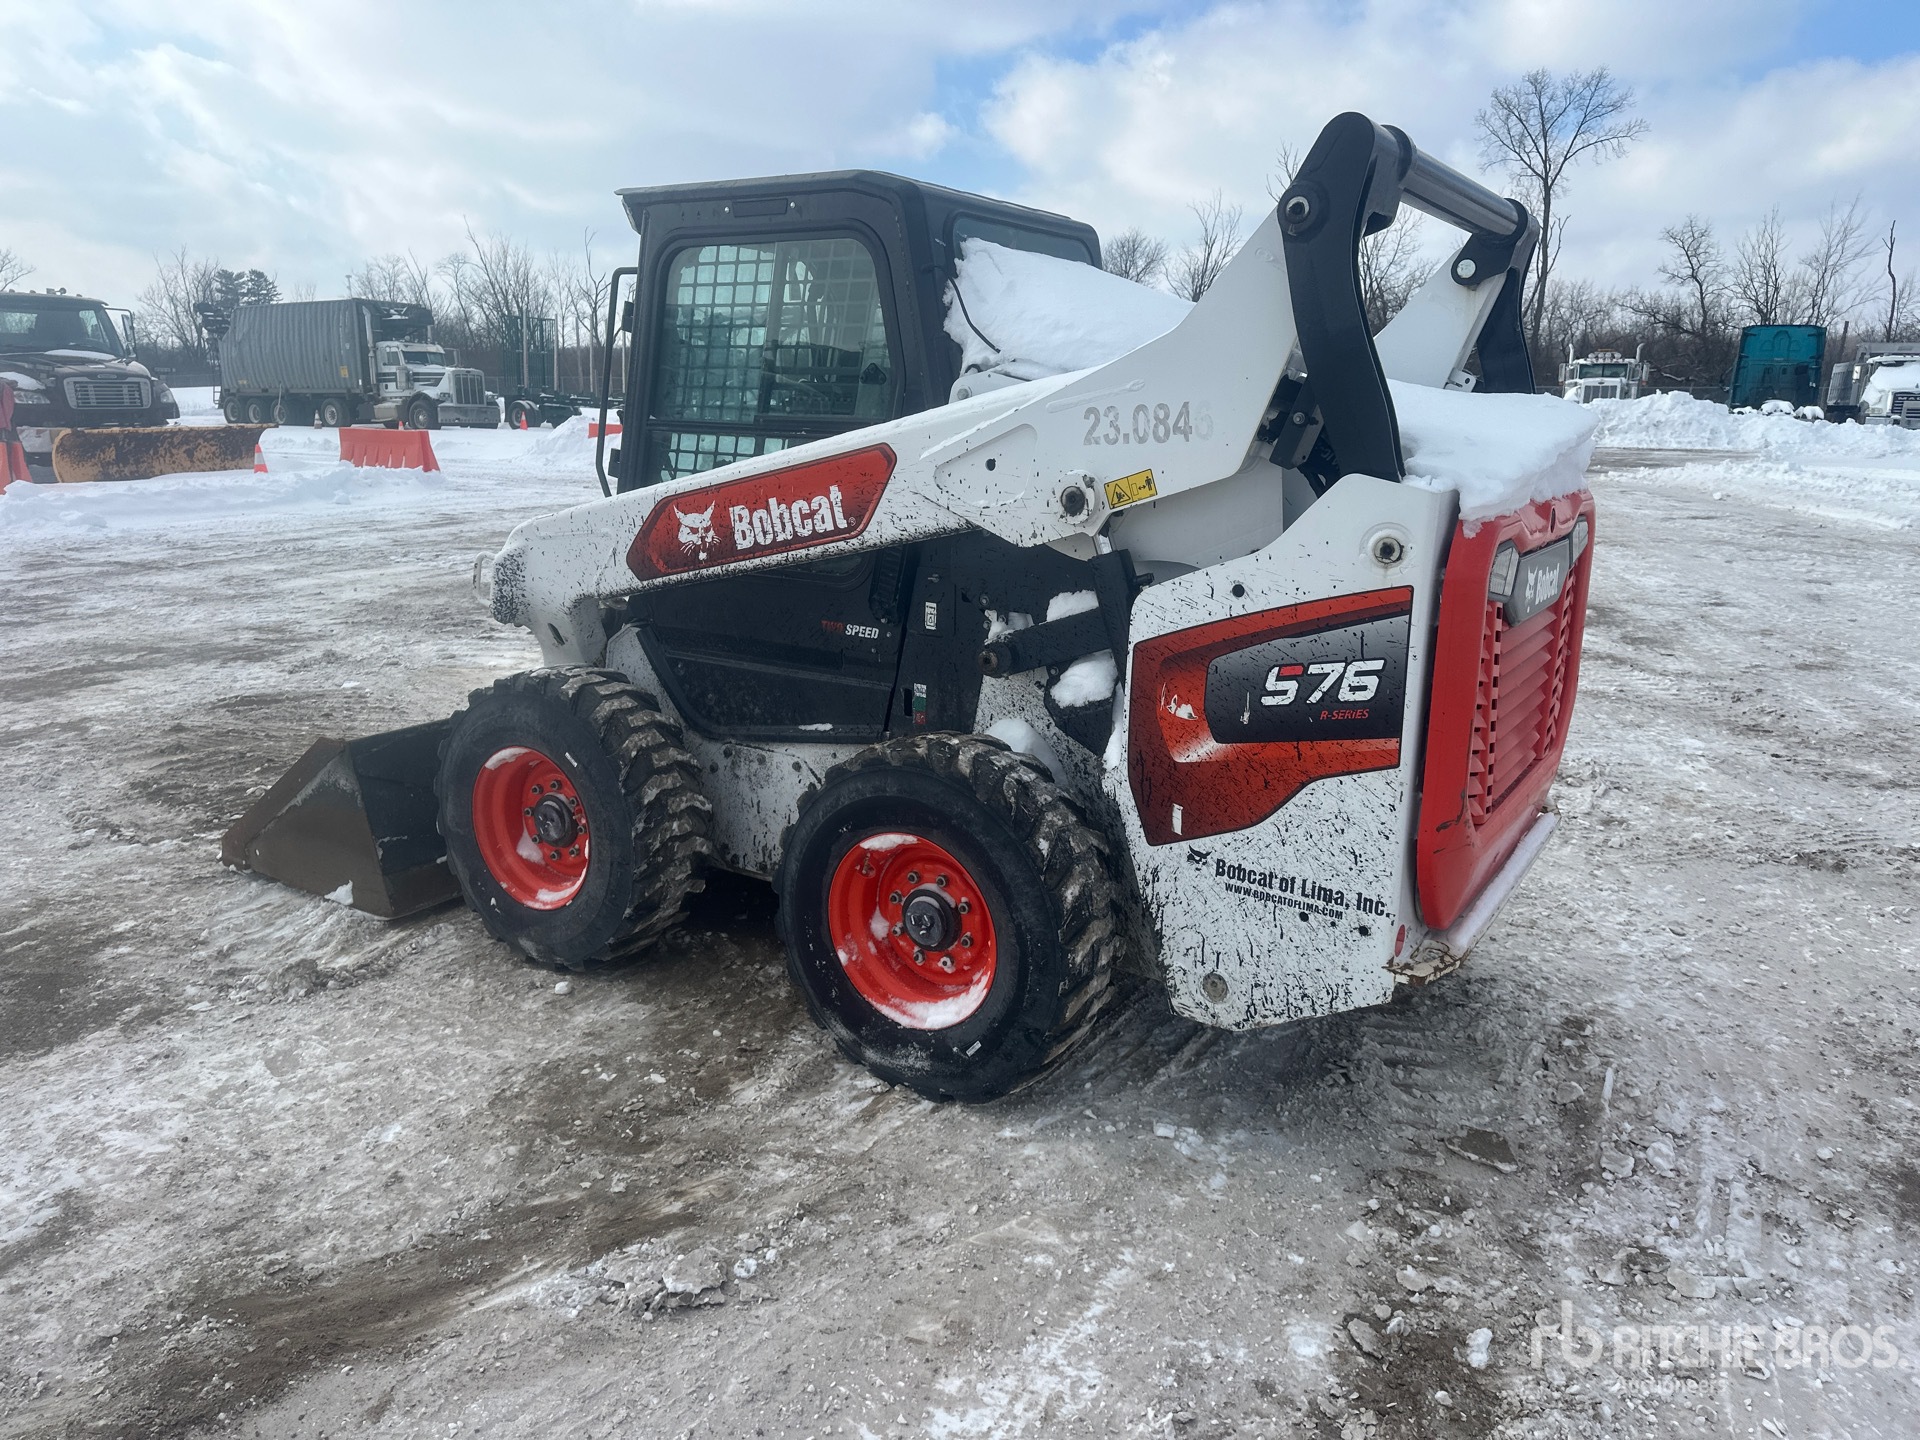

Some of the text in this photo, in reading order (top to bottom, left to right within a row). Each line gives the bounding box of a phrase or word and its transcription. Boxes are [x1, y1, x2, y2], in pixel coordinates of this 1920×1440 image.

[728, 484, 848, 550] Bobcat
[845, 623, 879, 639] SPEED
[1260, 659, 1385, 706] S76
[1215, 858, 1391, 917] Bobcat of Lima, Inc.
[1225, 882, 1343, 920] WWW.BOBCATOFLIMA.COM
